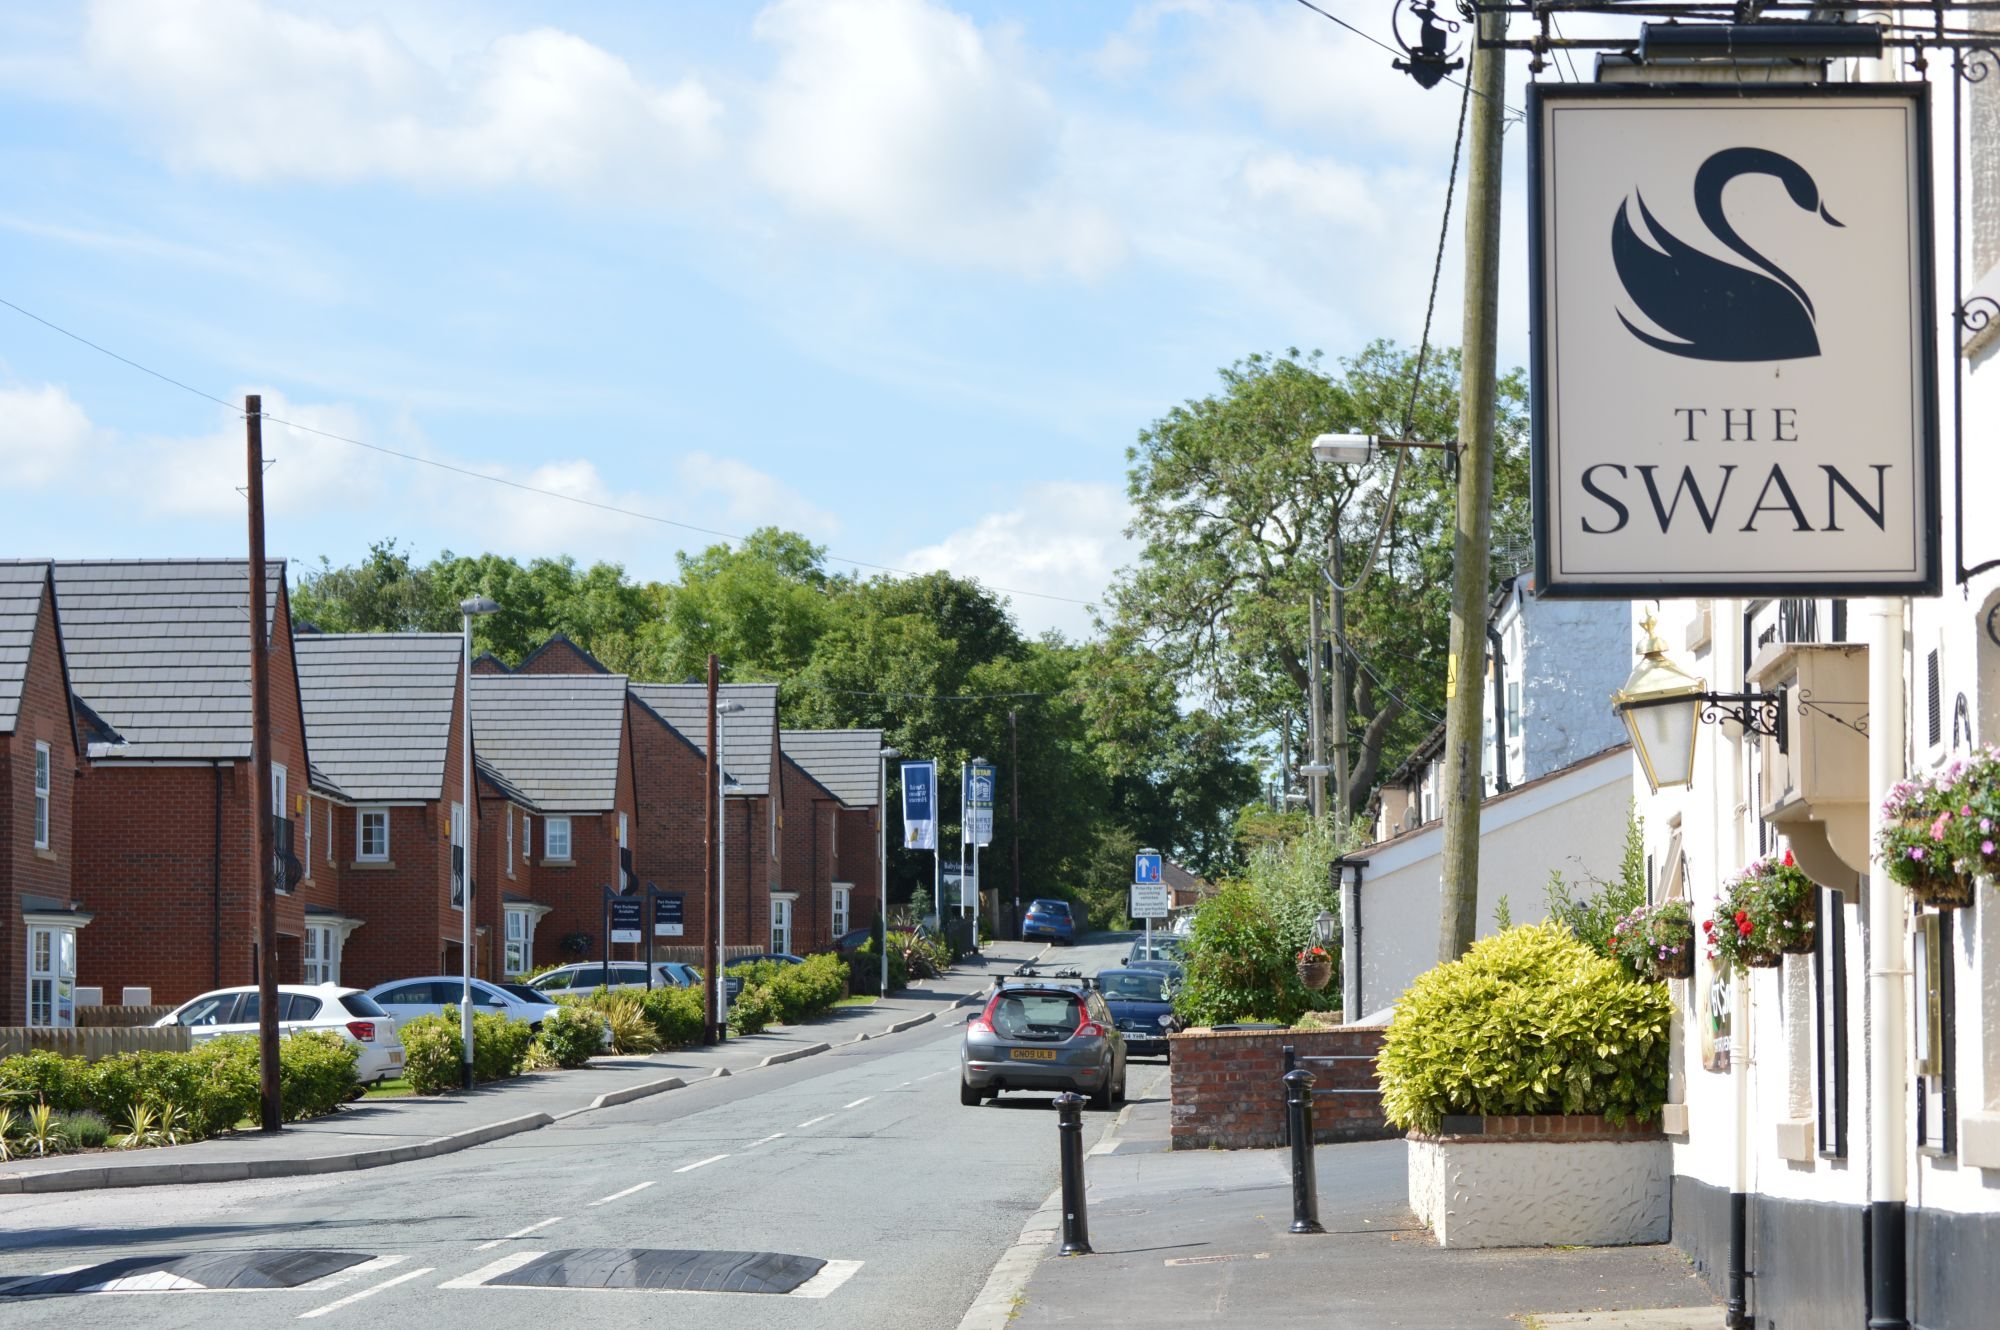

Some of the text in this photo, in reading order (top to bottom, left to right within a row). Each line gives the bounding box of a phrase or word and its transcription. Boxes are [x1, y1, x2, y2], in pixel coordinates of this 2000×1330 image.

[1674, 408, 1799, 442] THE
[1580, 462, 1894, 534] SWAN
[1013, 1050, 1035, 1058] GN09
